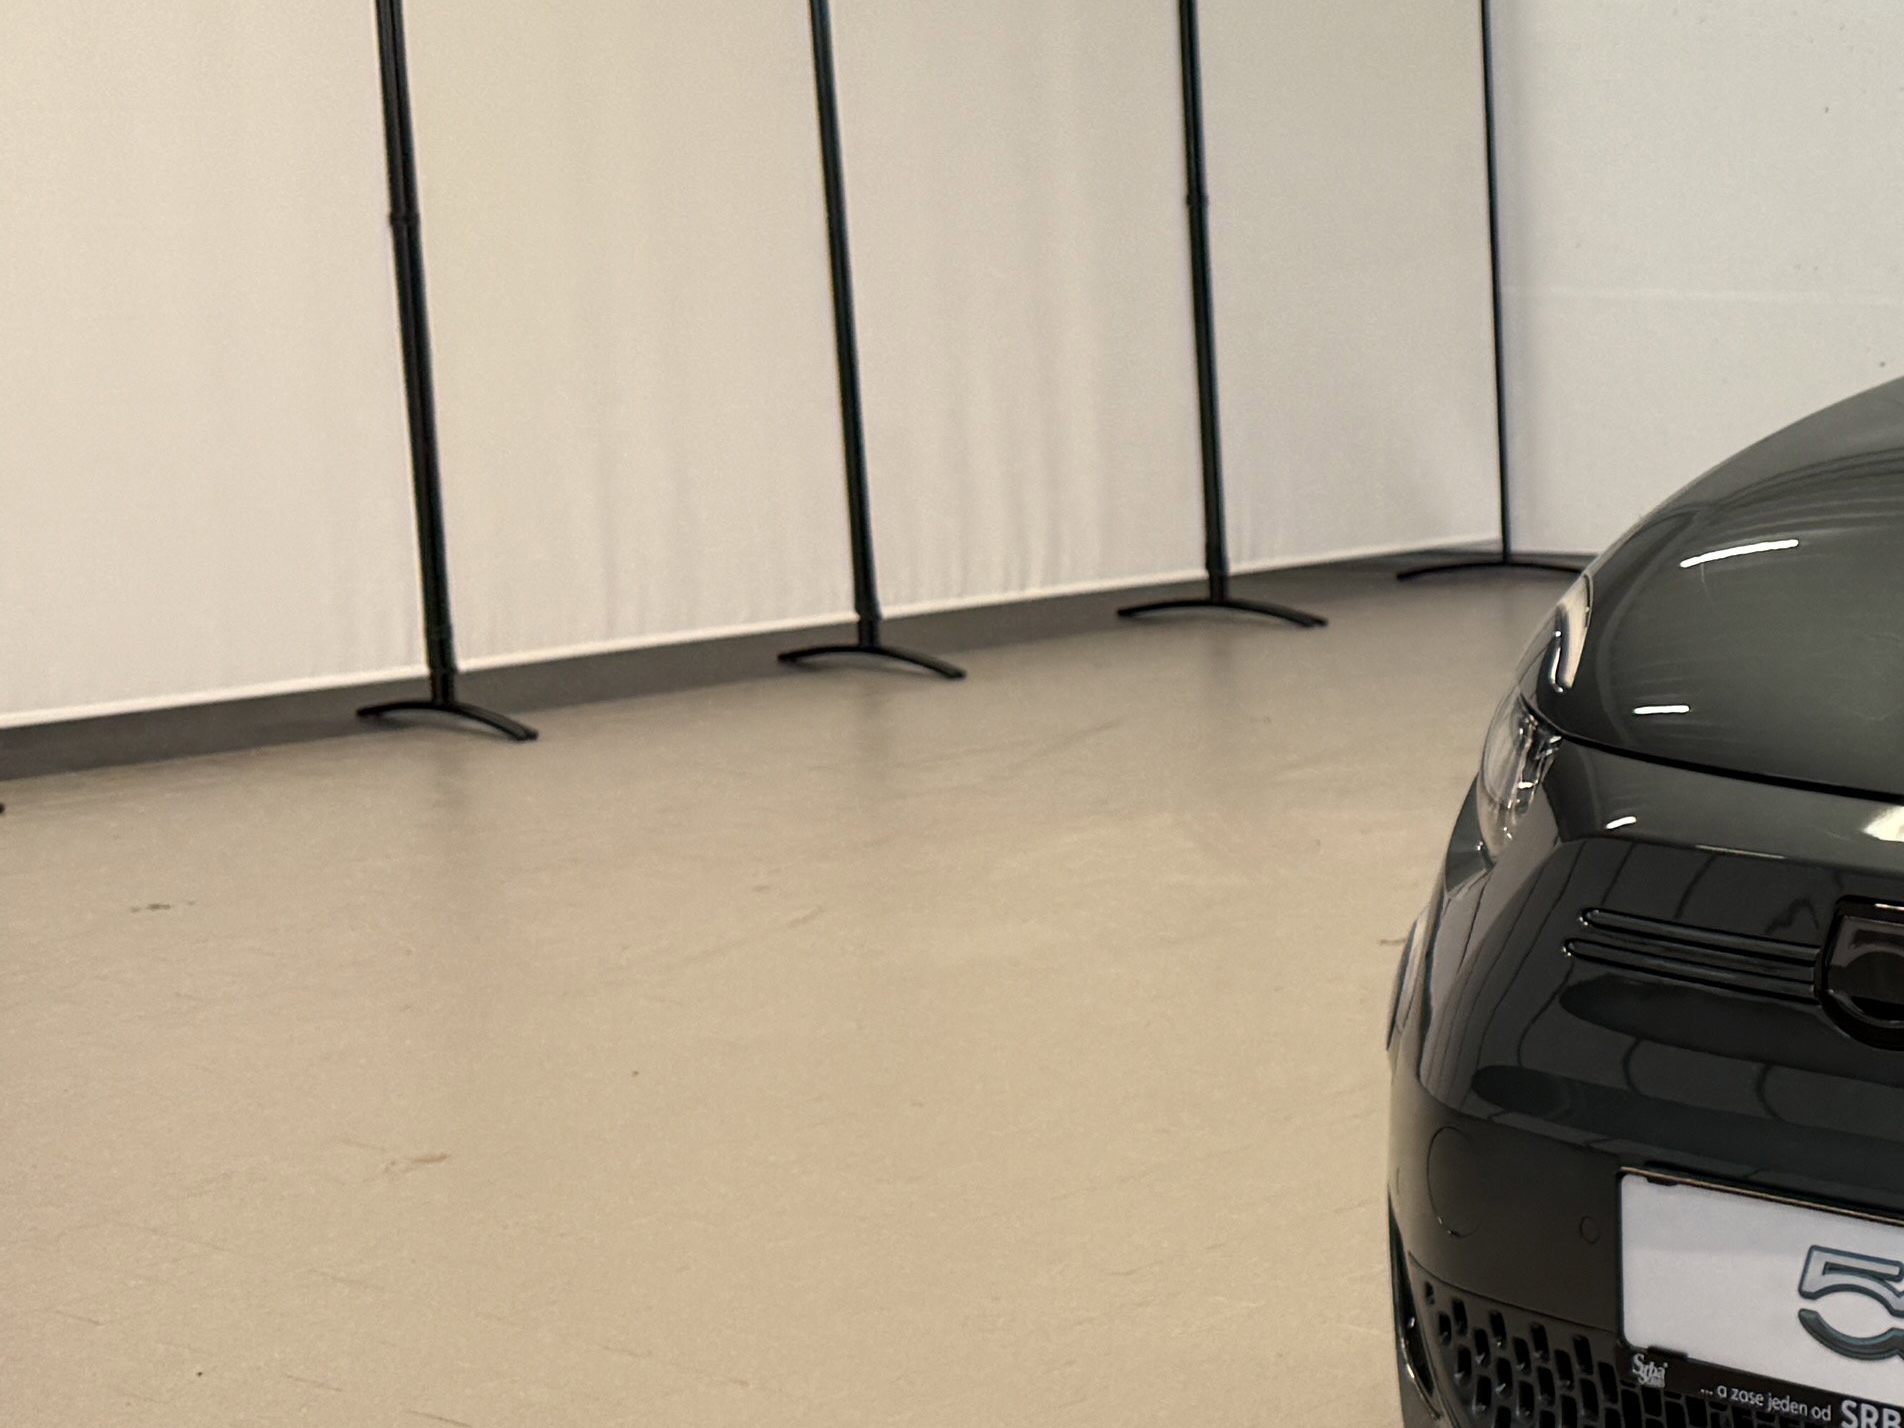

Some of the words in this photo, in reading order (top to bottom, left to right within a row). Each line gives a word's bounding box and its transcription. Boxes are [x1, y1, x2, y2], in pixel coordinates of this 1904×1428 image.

[1717, 1384, 1728, 1399] a
[1731, 1387, 1765, 1406] zase
[1766, 1391, 1808, 1417] jeden
[1811, 1404, 1832, 1422] od
